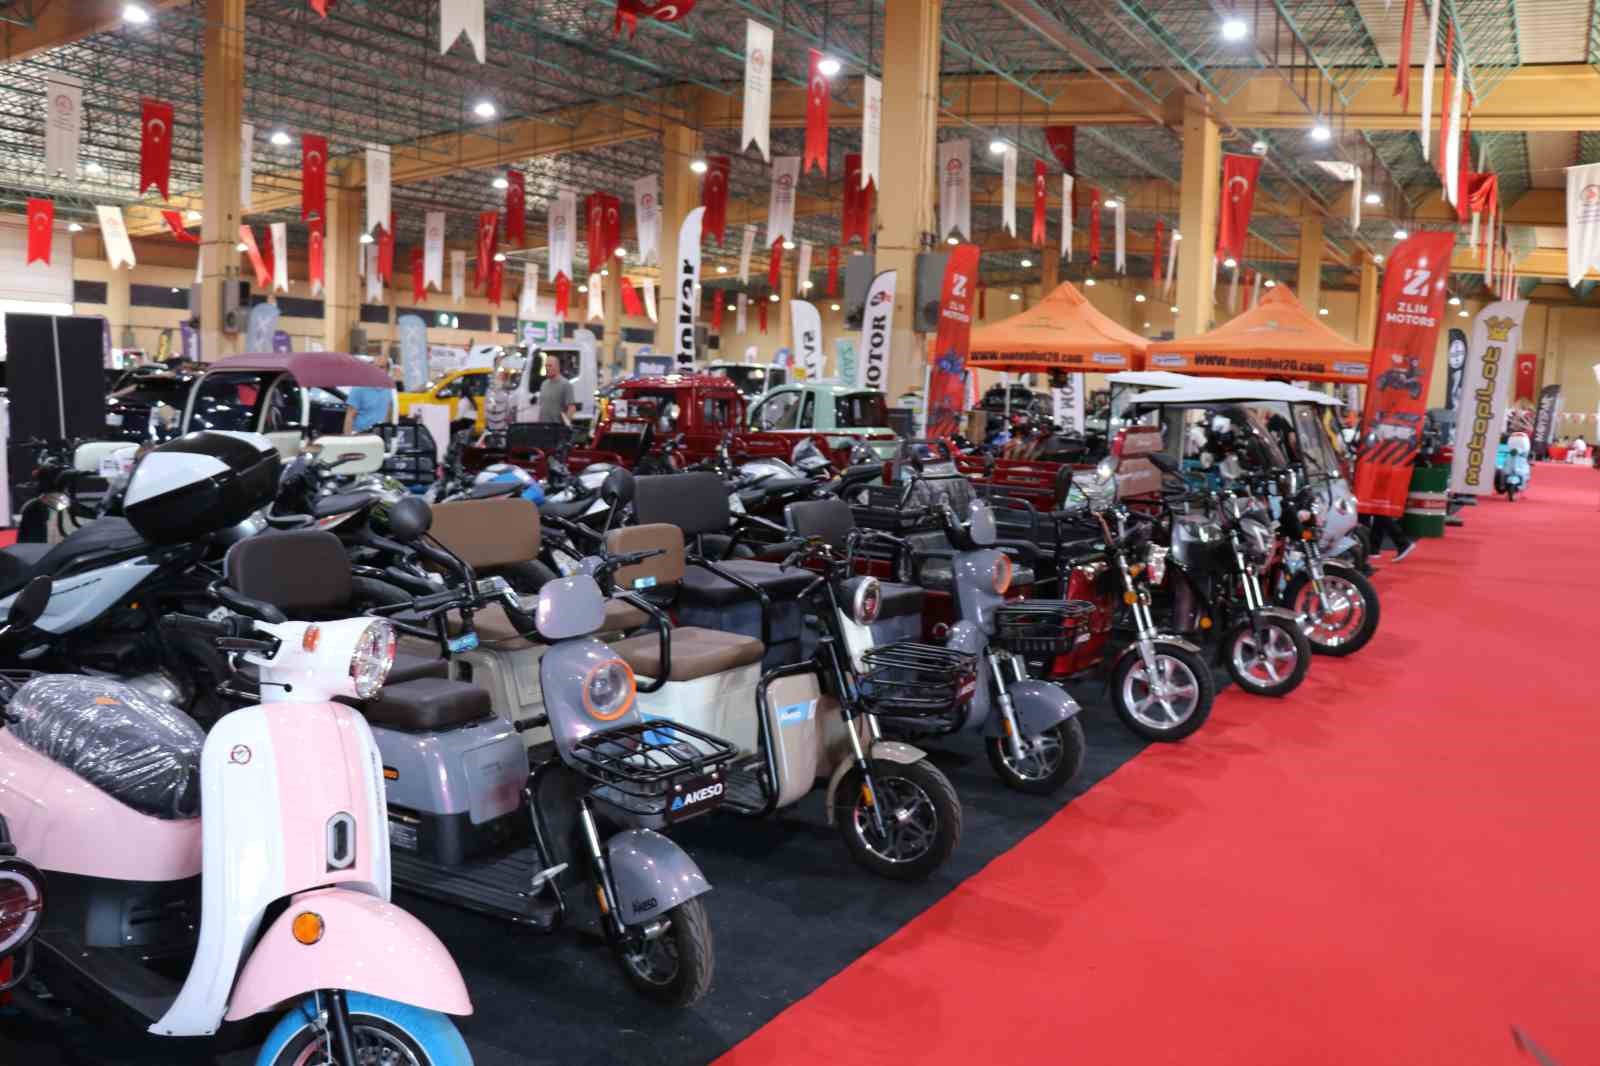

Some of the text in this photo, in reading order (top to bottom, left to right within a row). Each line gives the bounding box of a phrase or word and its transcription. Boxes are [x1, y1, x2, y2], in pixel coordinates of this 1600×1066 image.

[677, 259, 694, 372] tokar
[1397, 301, 1428, 314] ZLIN
[1385, 311, 1436, 328] MOTORS
[683, 783, 723, 805] AKESO
